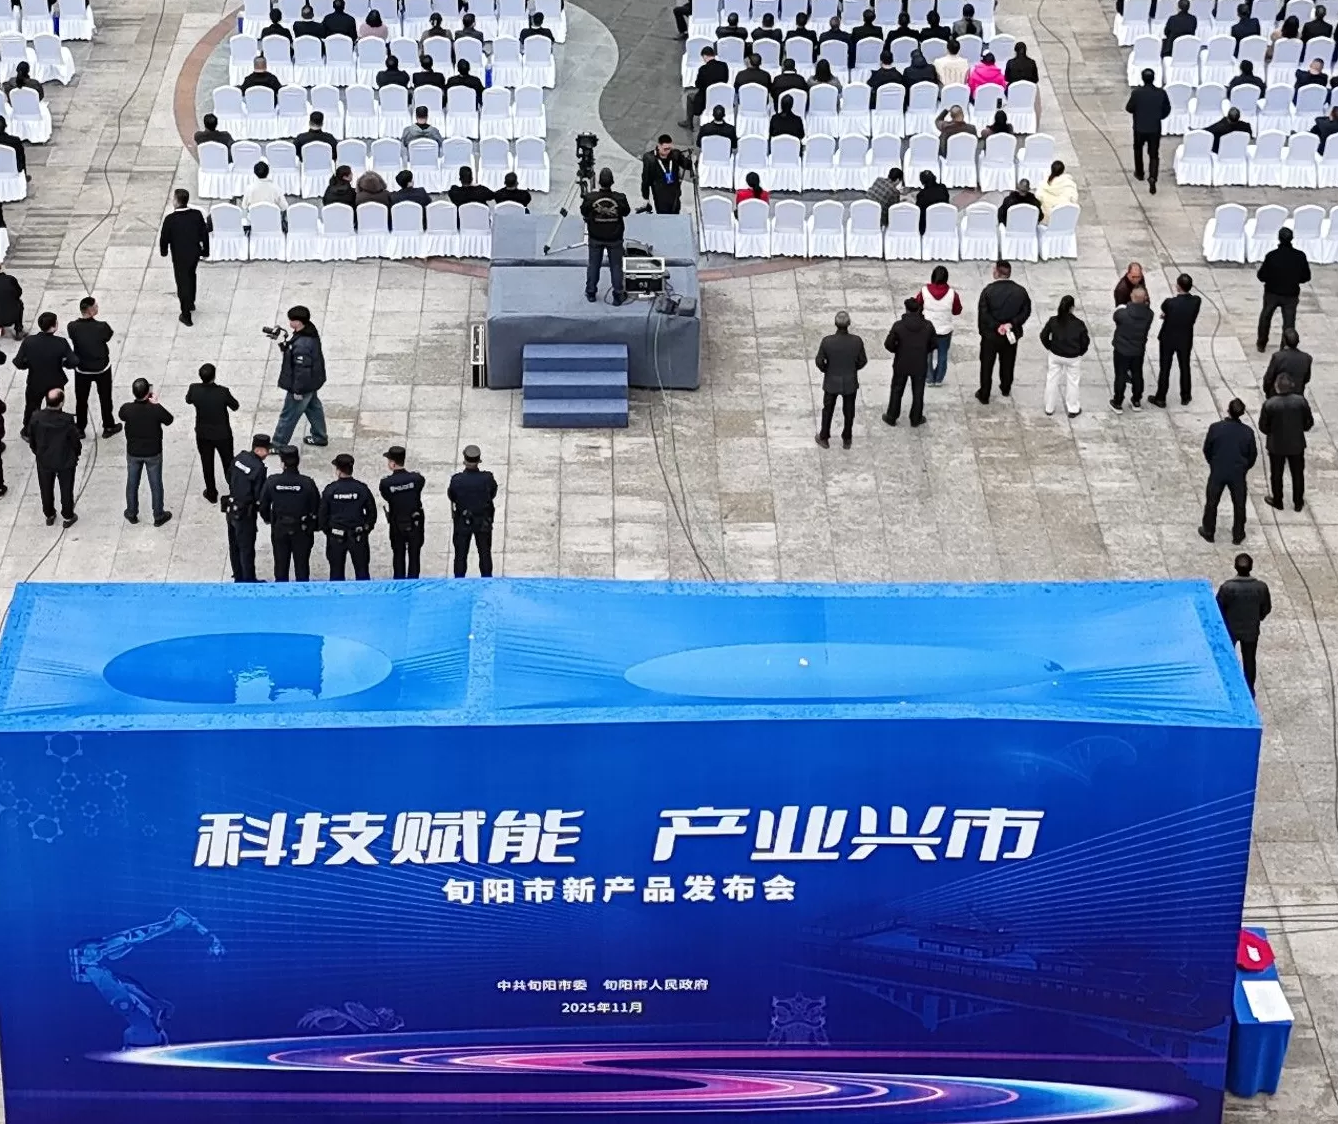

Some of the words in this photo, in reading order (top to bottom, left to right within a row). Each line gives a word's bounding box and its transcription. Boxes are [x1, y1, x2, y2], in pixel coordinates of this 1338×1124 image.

[194, 810, 585, 867] 科技赋能
[652, 805, 1046, 862] 产业兴市
[442, 874, 796, 905] 旬阳市新产品发布会
[497, 979, 588, 992] 中共旬阳市委
[603, 978, 709, 991] 旬阳市人民政府
[562, 1001, 643, 1014] 2025年11月
